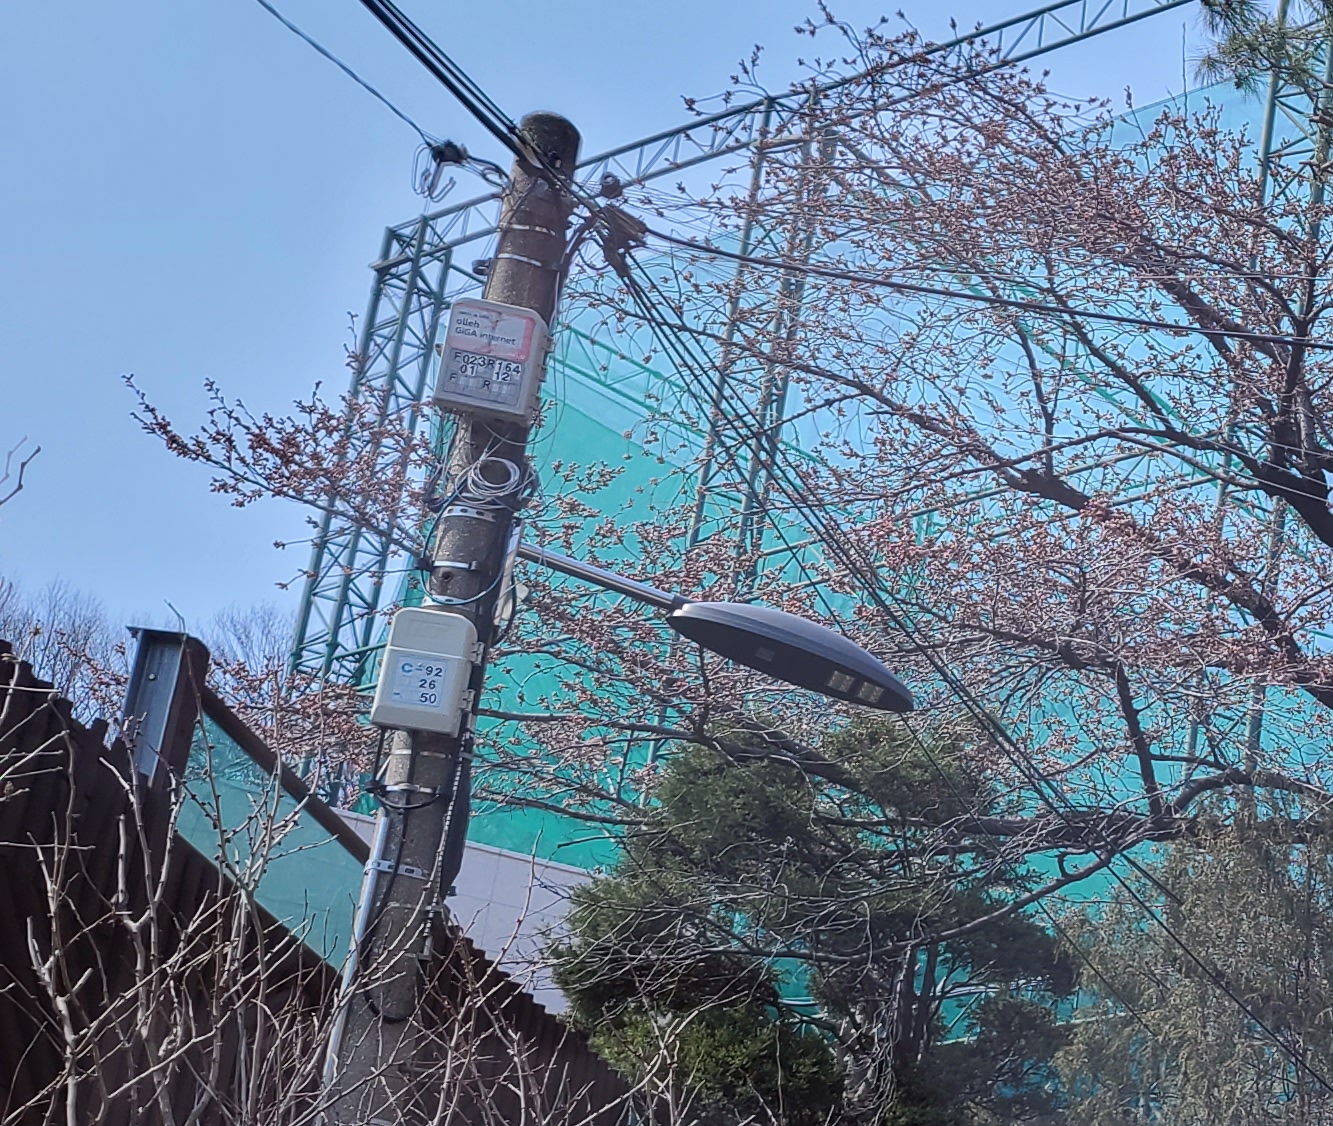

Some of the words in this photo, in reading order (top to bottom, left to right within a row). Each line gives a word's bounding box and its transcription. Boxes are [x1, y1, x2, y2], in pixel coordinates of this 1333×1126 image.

[457, 318, 480, 328] olleh
[480, 333, 517, 346] internet
[494, 372, 510, 381] 12
[419, 679, 436, 690] 26
[419, 692, 437, 704] 50
